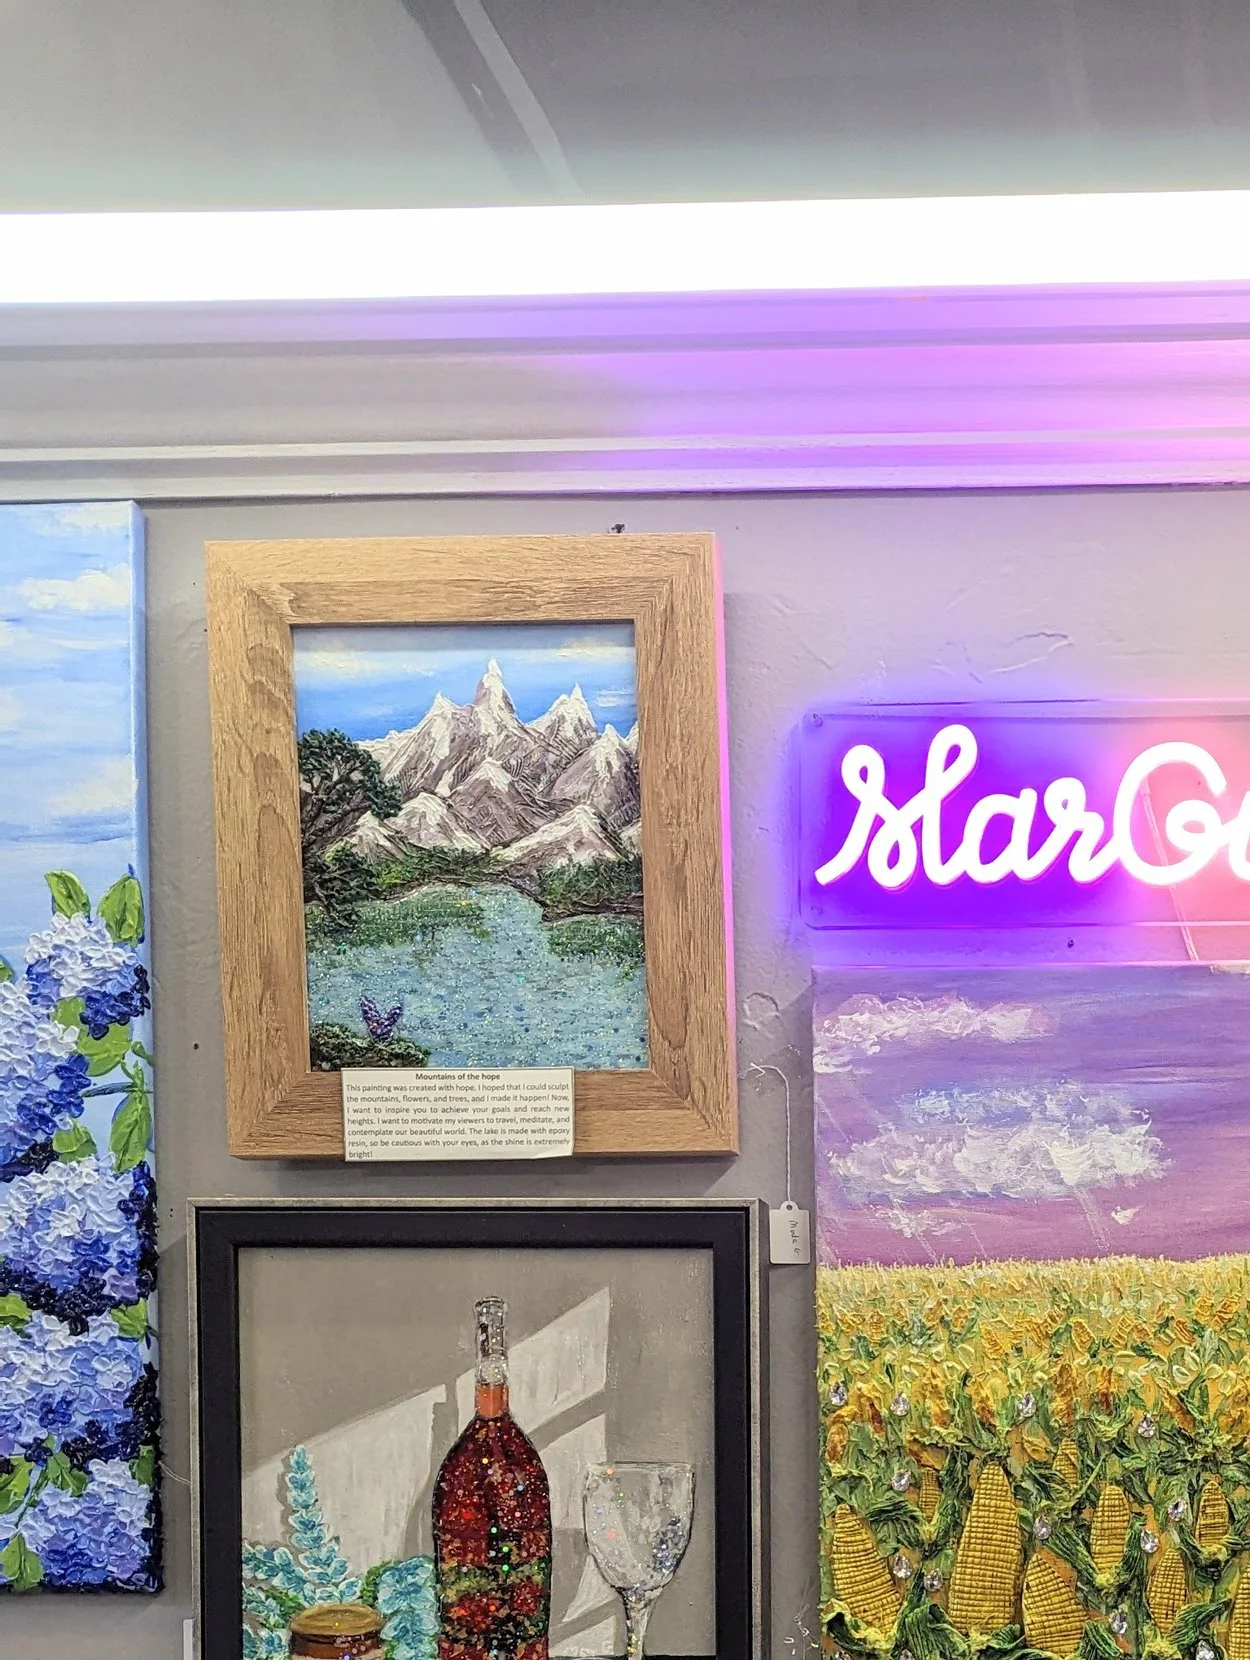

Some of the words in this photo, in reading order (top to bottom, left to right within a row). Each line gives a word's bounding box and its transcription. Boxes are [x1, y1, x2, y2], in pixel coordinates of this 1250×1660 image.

[482, 1073, 500, 1081] hope
[548, 1083, 569, 1091] sculpt
[403, 1095, 431, 1103] flowers,
[520, 1094, 549, 1102] happen!
[492, 1106, 510, 1114] goals
